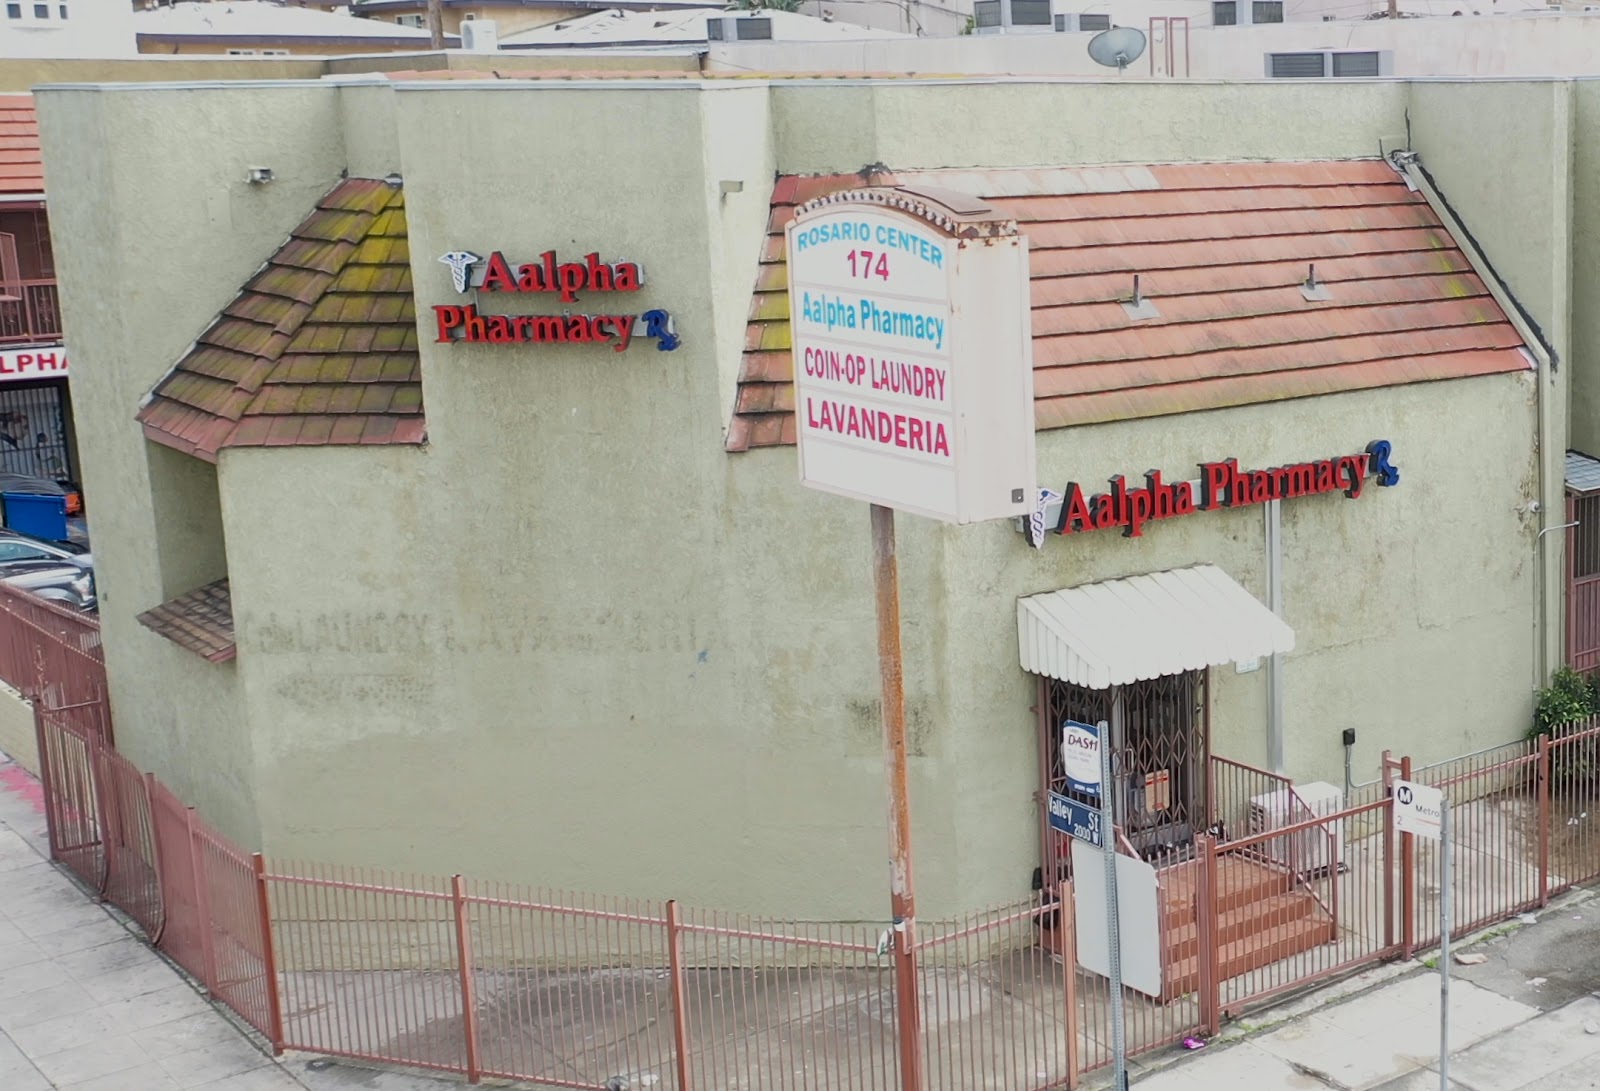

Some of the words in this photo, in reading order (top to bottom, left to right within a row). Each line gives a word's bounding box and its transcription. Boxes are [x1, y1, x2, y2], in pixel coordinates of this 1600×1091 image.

[797, 222, 870, 252] ROSARIO
[876, 226, 943, 270] CENTER
[847, 249, 890, 281] 174
[480, 250, 643, 303] Aalpha
[431, 304, 638, 352] Pharmacy
[802, 291, 857, 332] Aalpha
[860, 299, 944, 350] Pharmacy
[871, 357, 946, 401] LAUNDRY
[807, 397, 950, 457] LAVANDERIA
[1054, 468, 1196, 538] Aalpha
[1197, 457, 1369, 511] Pharmacy
[1068, 734, 1098, 751] DASH
[1048, 795, 1072, 825] Valley
[1088, 811, 1099, 832] St
[1073, 822, 1091, 842] 2000
[1415, 804, 1440, 818] Metro
